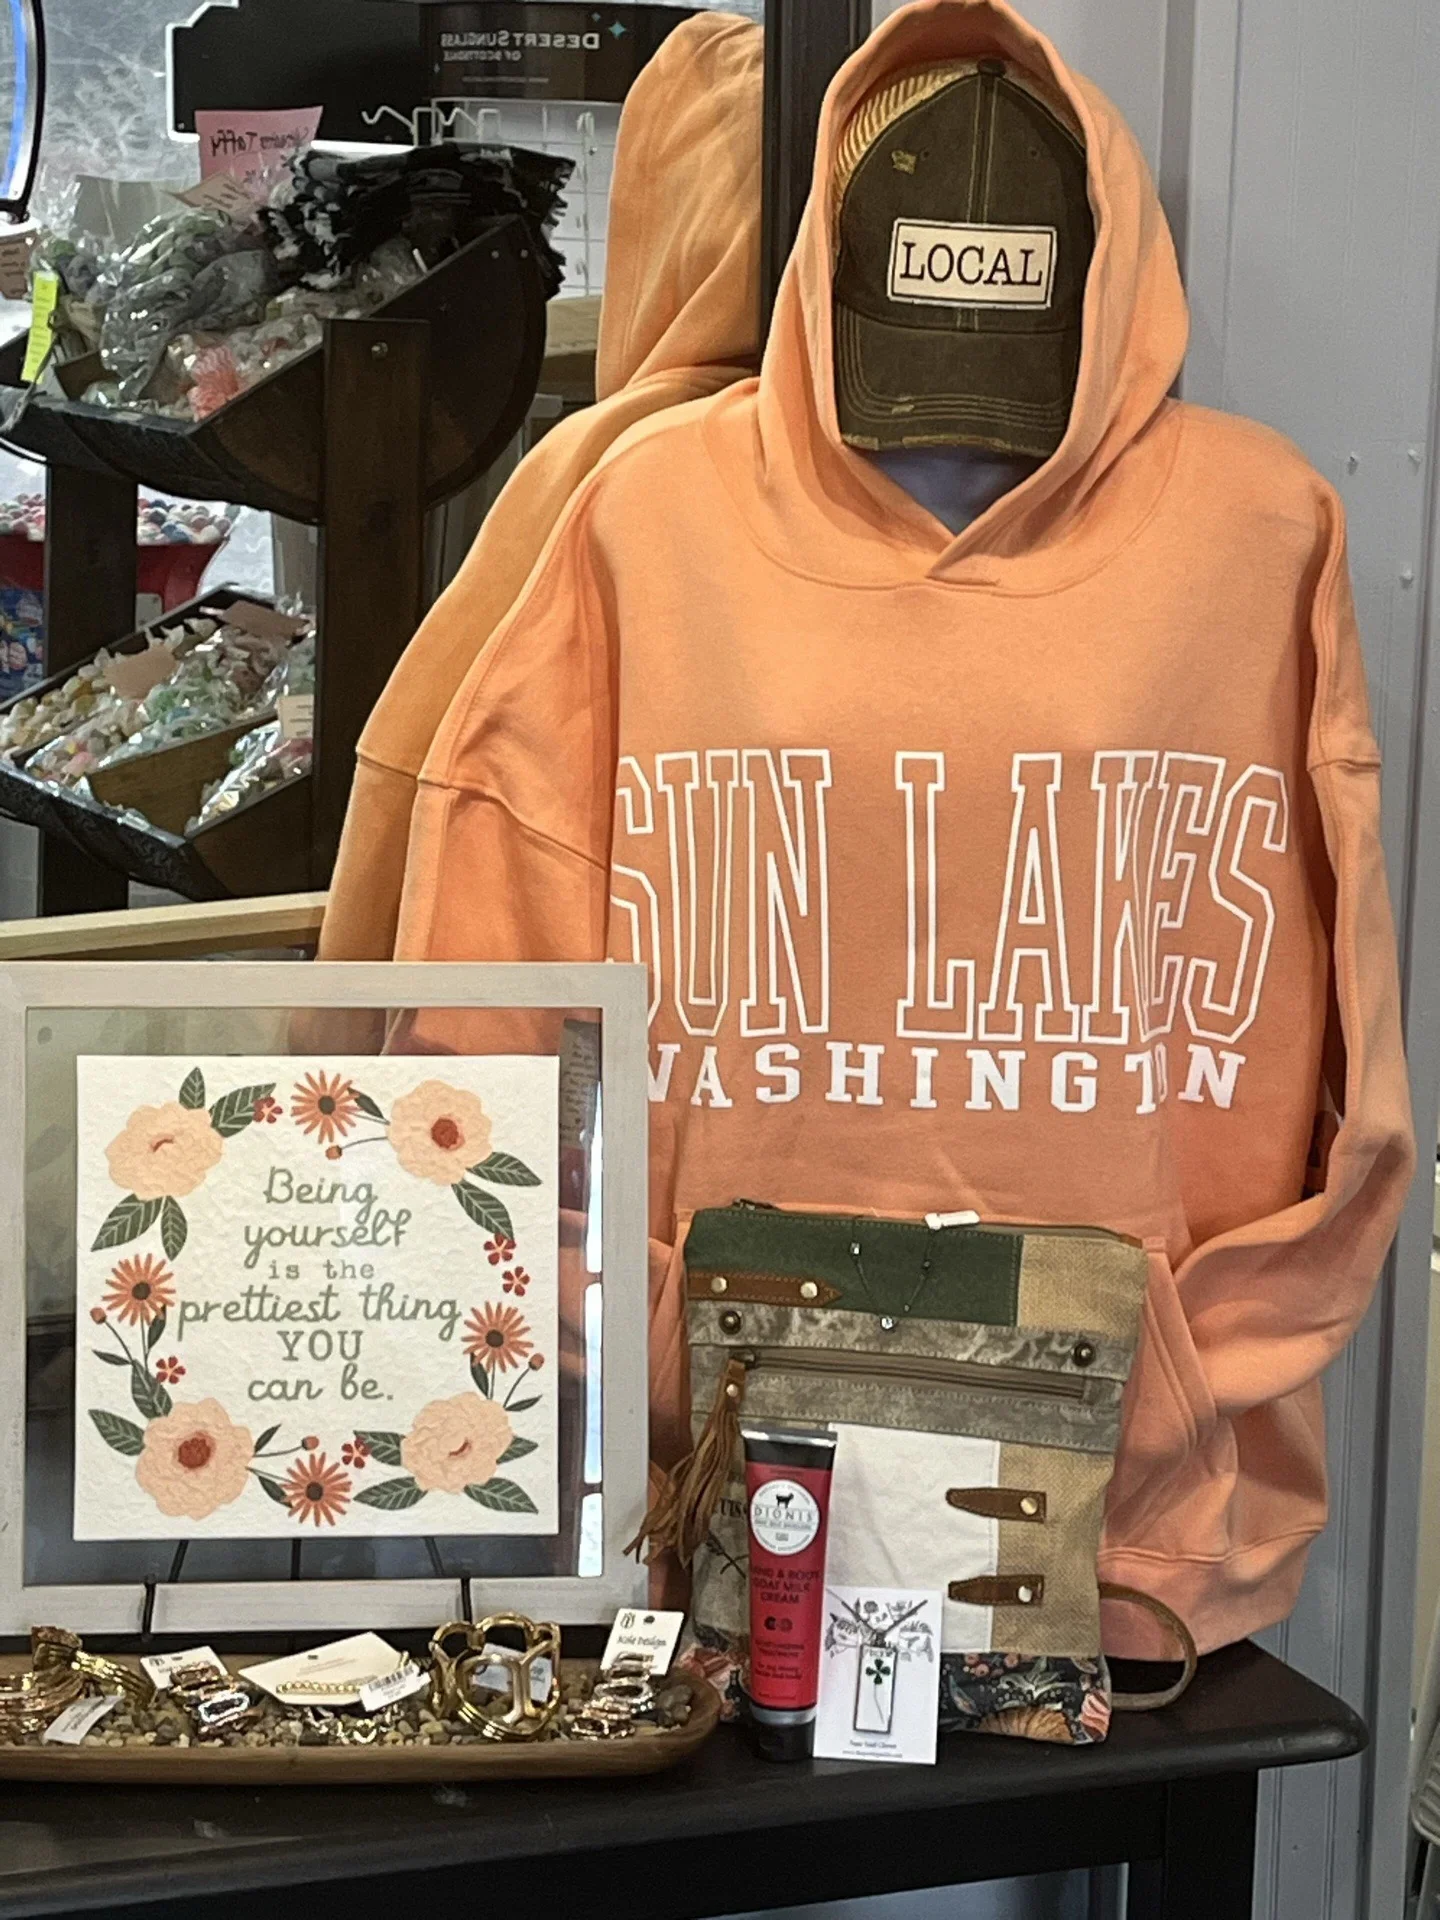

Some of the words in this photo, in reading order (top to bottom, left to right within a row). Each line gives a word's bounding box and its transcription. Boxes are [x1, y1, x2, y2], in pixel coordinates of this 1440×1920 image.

[900, 241, 1043, 286] LOCAL
[610, 748, 832, 1036] SUN
[895, 750, 1289, 1045] LAKES
[263, 1165, 378, 1226] Being
[243, 1208, 412, 1270] yourself
[268, 1260, 300, 1280] is
[322, 1259, 375, 1280] the
[177, 1283, 341, 1342] prettiest
[358, 1282, 462, 1342] thing
[276, 1328, 364, 1362] YOU
[247, 1378, 323, 1401] can
[339, 1362, 394, 1401] be.
